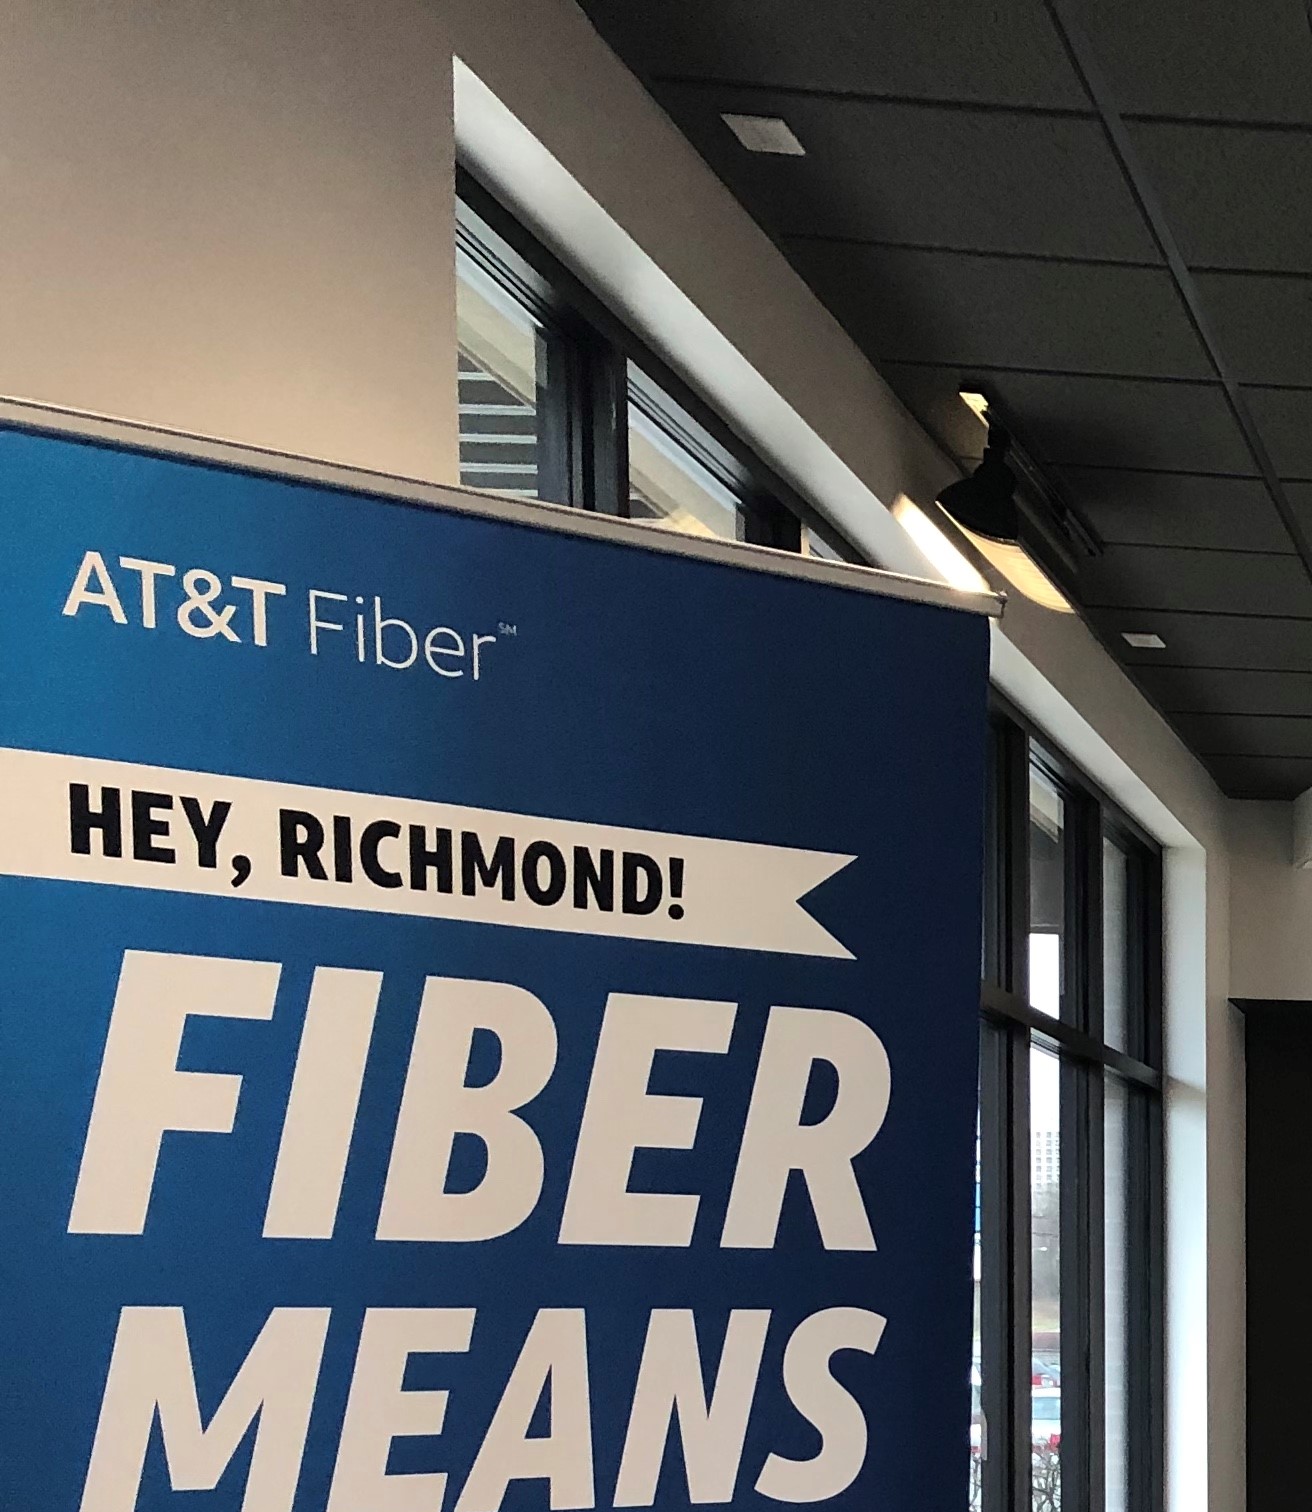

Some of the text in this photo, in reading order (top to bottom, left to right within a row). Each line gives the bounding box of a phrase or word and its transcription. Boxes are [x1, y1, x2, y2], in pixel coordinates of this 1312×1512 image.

[62, 550, 287, 647] AT&T
[309, 590, 498, 681] Fiber
[68, 782, 686, 921] HEY, RICHMOND!
[66, 949, 893, 1252] FIBER
